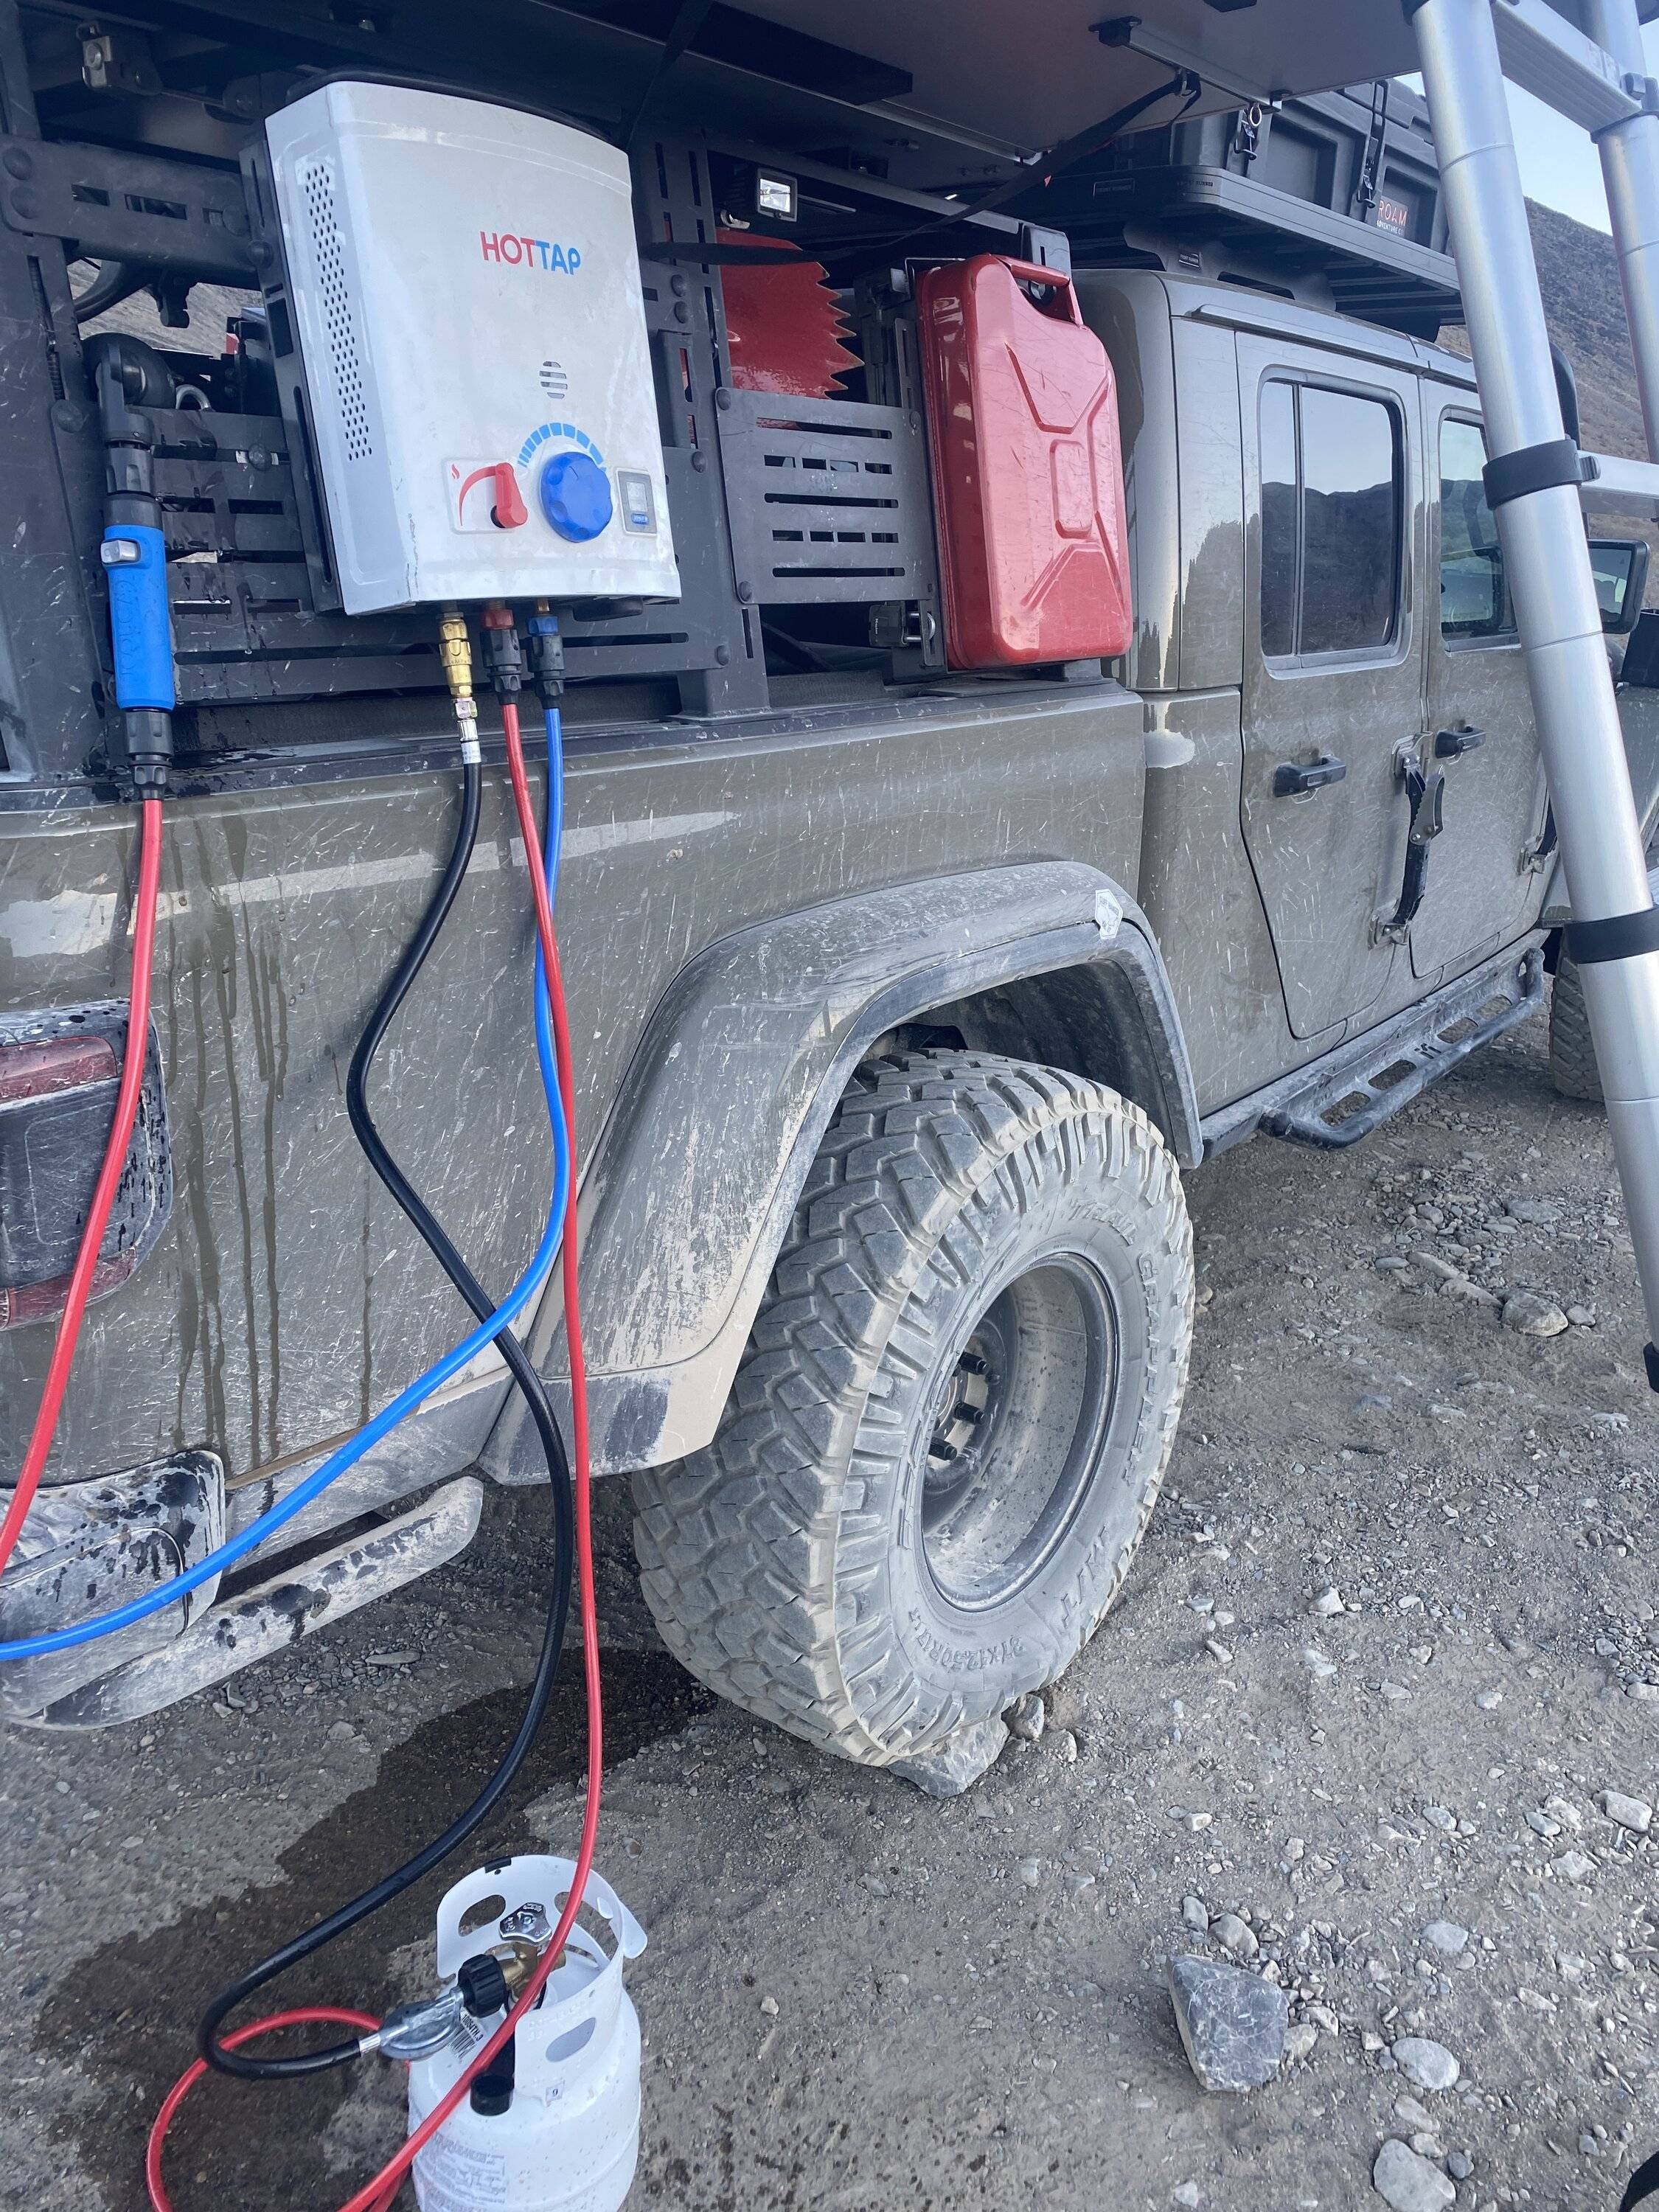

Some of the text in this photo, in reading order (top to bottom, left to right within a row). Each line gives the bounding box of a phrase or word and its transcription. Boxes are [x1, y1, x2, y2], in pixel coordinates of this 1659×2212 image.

[1376, 220, 1399, 234] ADVENTURE
[1378, 200, 1408, 227] ROAM
[479, 231, 581, 275] HOTTAP
